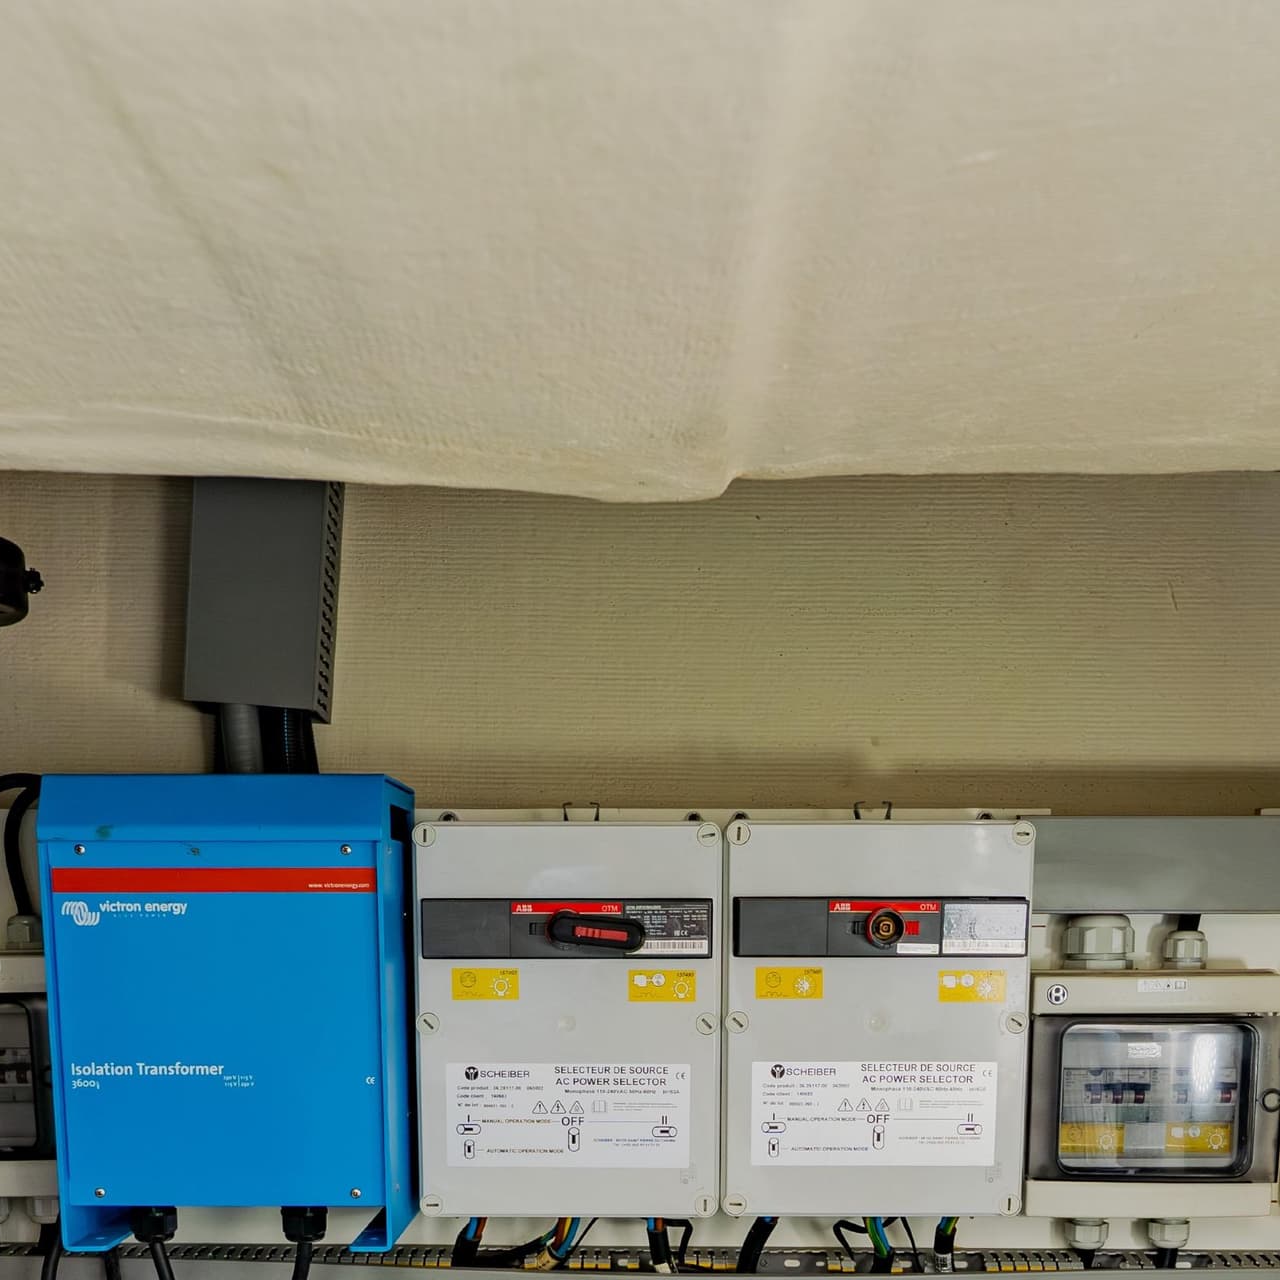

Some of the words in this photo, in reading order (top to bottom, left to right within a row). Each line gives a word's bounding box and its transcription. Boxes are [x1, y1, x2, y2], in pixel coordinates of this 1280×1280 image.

[99, 900, 141, 912] victron
[144, 902, 188, 915] energy
[515, 904, 533, 912] ABB
[601, 905, 619, 913] OTM
[833, 903, 851, 911] ABB
[919, 903, 937, 911] OTM
[71, 1062, 133, 1076] Isolation
[136, 1062, 225, 1076] Transformer
[554, 1066, 611, 1074] SELECTEUR
[613, 1066, 627, 1074] DE
[628, 1066, 669, 1074] SOURCE
[785, 1067, 837, 1076] SCHEIBER
[860, 1063, 918, 1072] SELECTEUR
[920, 1063, 934, 1072] DE
[935, 1063, 976, 1072] SOURCE
[479, 1070, 530, 1078] SCHEIBER
[555, 1078, 570, 1086] AC
[572, 1078, 610, 1086] POWER
[612, 1078, 667, 1086] SELECTOR
[862, 1075, 877, 1083] AC
[879, 1075, 917, 1083] POWER
[919, 1075, 974, 1083] SELECTOR
[561, 1116, 585, 1126] OFF
[866, 1114, 890, 1124] OFF
